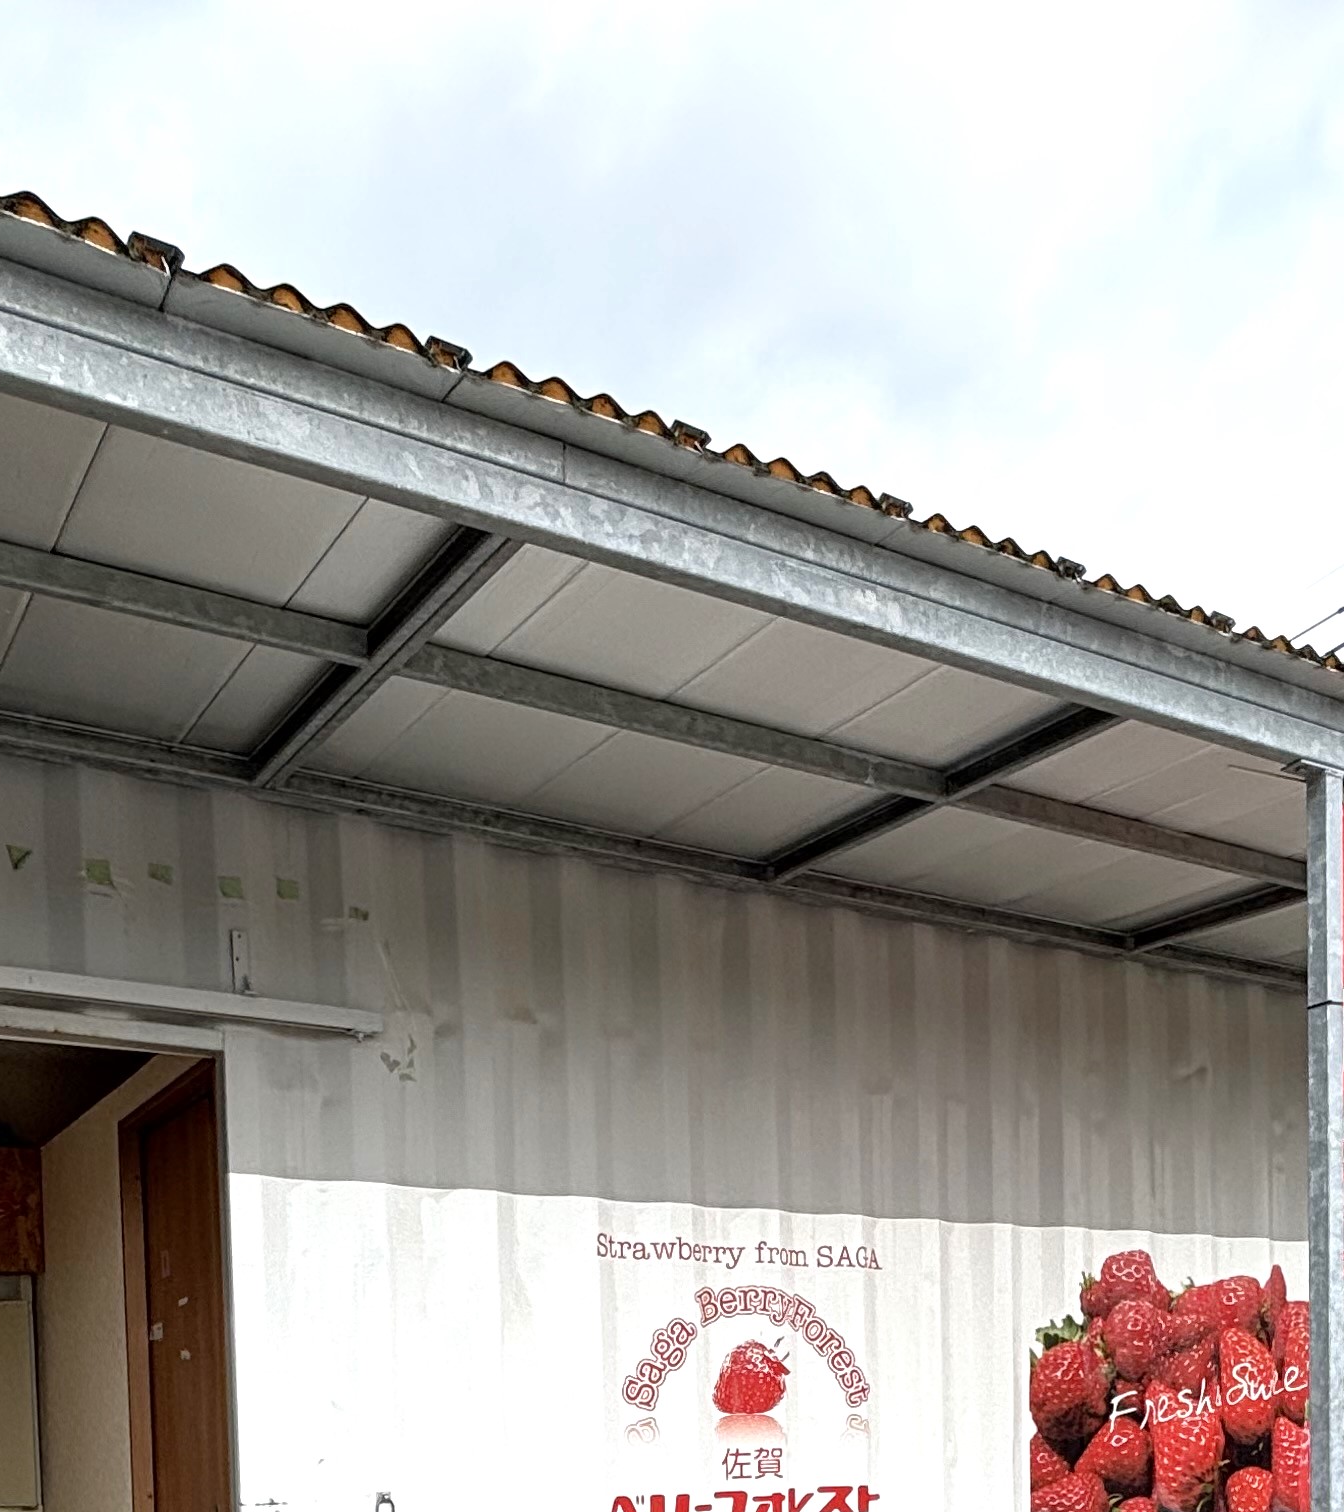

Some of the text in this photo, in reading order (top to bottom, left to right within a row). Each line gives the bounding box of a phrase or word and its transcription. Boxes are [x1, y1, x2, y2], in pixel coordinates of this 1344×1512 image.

[597, 1232, 883, 1270] Strawberry from SAGA
[622, 1317, 698, 1411] Saga
[1109, 1377, 1216, 1433] Fresh
[722, 1448, 783, 1480] 佐賀
